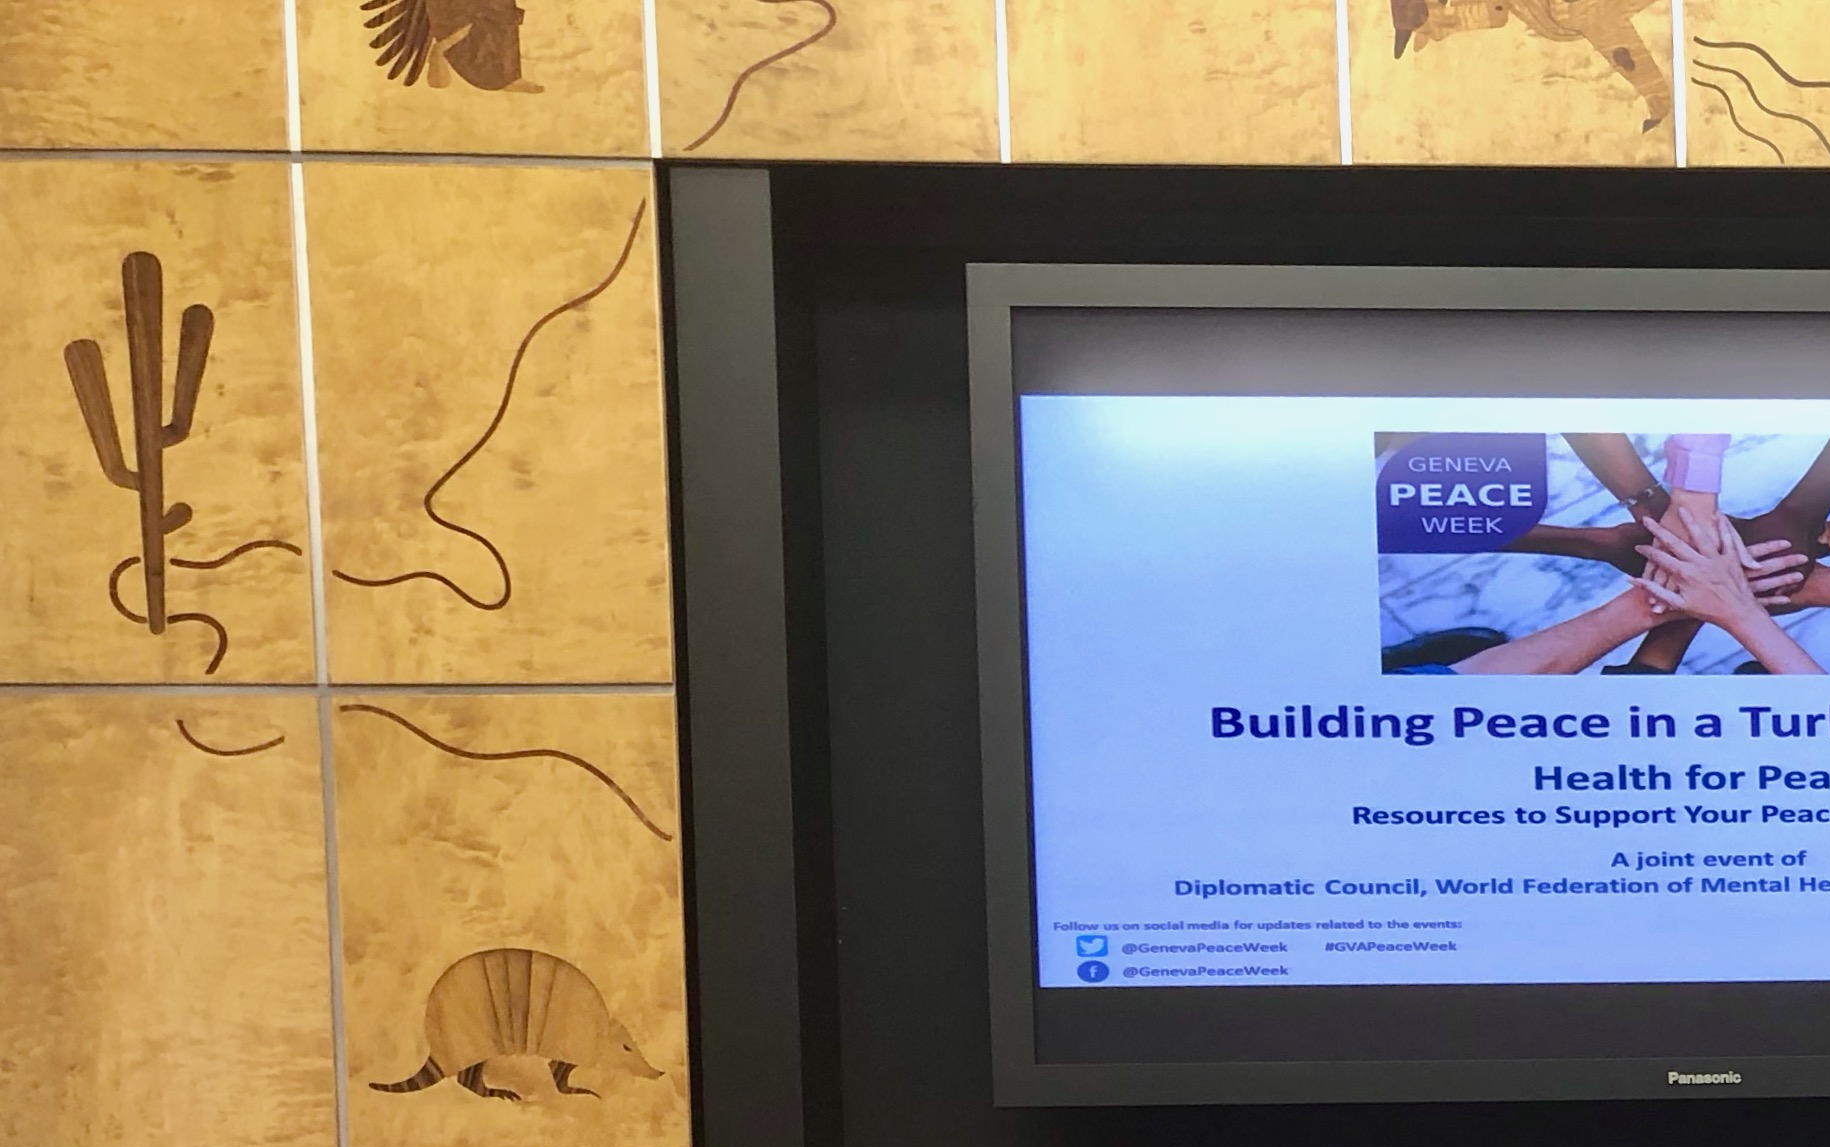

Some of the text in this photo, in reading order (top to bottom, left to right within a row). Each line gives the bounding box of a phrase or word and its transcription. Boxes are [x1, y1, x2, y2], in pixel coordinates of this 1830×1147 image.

[1409, 457, 1512, 472] GENEVA
[1390, 484, 1532, 506] PEACE
[1422, 517, 1502, 533] WEEK
[1212, 705, 1434, 746] Building
[1454, 707, 1610, 738] Peace
[1630, 706, 1675, 738] in
[1694, 714, 1721, 737] a
[1535, 764, 1671, 790] Health
[1685, 764, 1745, 790] for
[1353, 807, 1505, 824] Resources
[1515, 808, 1546, 824] to
[1556, 806, 1676, 828] Support
[1684, 806, 1752, 823] Your
[1611, 850, 1807, 871] A joint event of
[1175, 879, 1314, 899] Diplomatic
[1325, 878, 1427, 897] Council,
[1435, 878, 1513, 894] World
[1523, 878, 1659, 894] Federation
[1667, 877, 1693, 893] of
[1702, 876, 1790, 892] Mental
[1053, 920, 1462, 932] Follow us on social media for updates related to the events:
[1122, 942, 1288, 955] @GenevaPeaceWeek
[1325, 941, 1457, 952] #GVAPeaceWeek
[1123, 965, 1288, 978] @GenevaPeaceWeek
[1668, 1071, 1742, 1084] Panasonic
